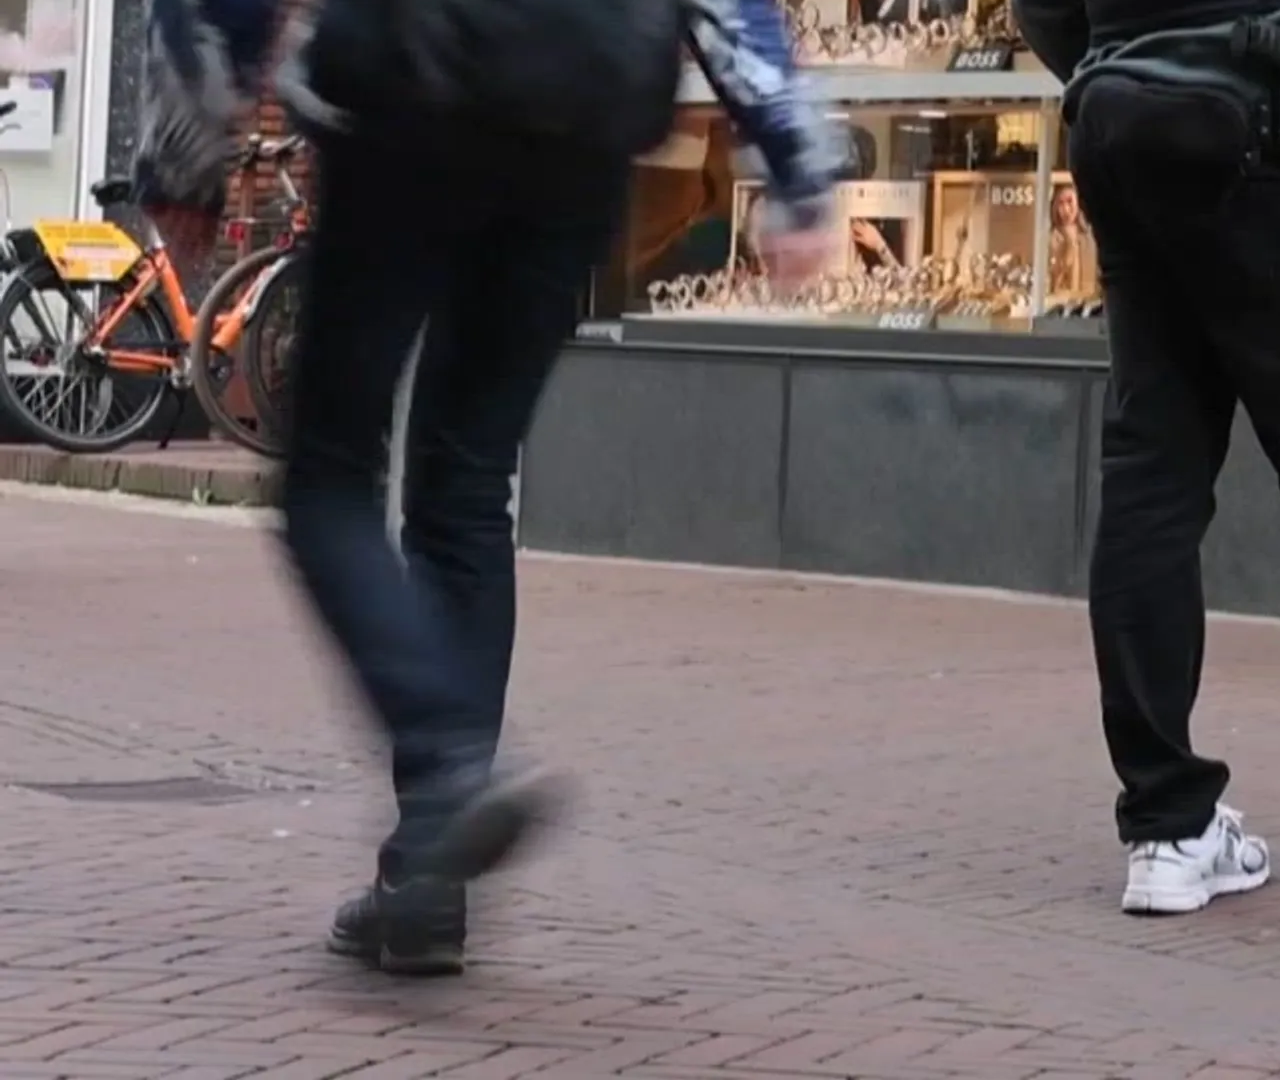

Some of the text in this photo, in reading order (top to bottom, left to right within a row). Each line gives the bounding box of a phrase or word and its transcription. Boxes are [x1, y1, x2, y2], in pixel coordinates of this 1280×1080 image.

[954, 50, 1001, 69] BOSS
[991, 185, 1035, 205] BOSS
[877, 311, 926, 330] BOSS
